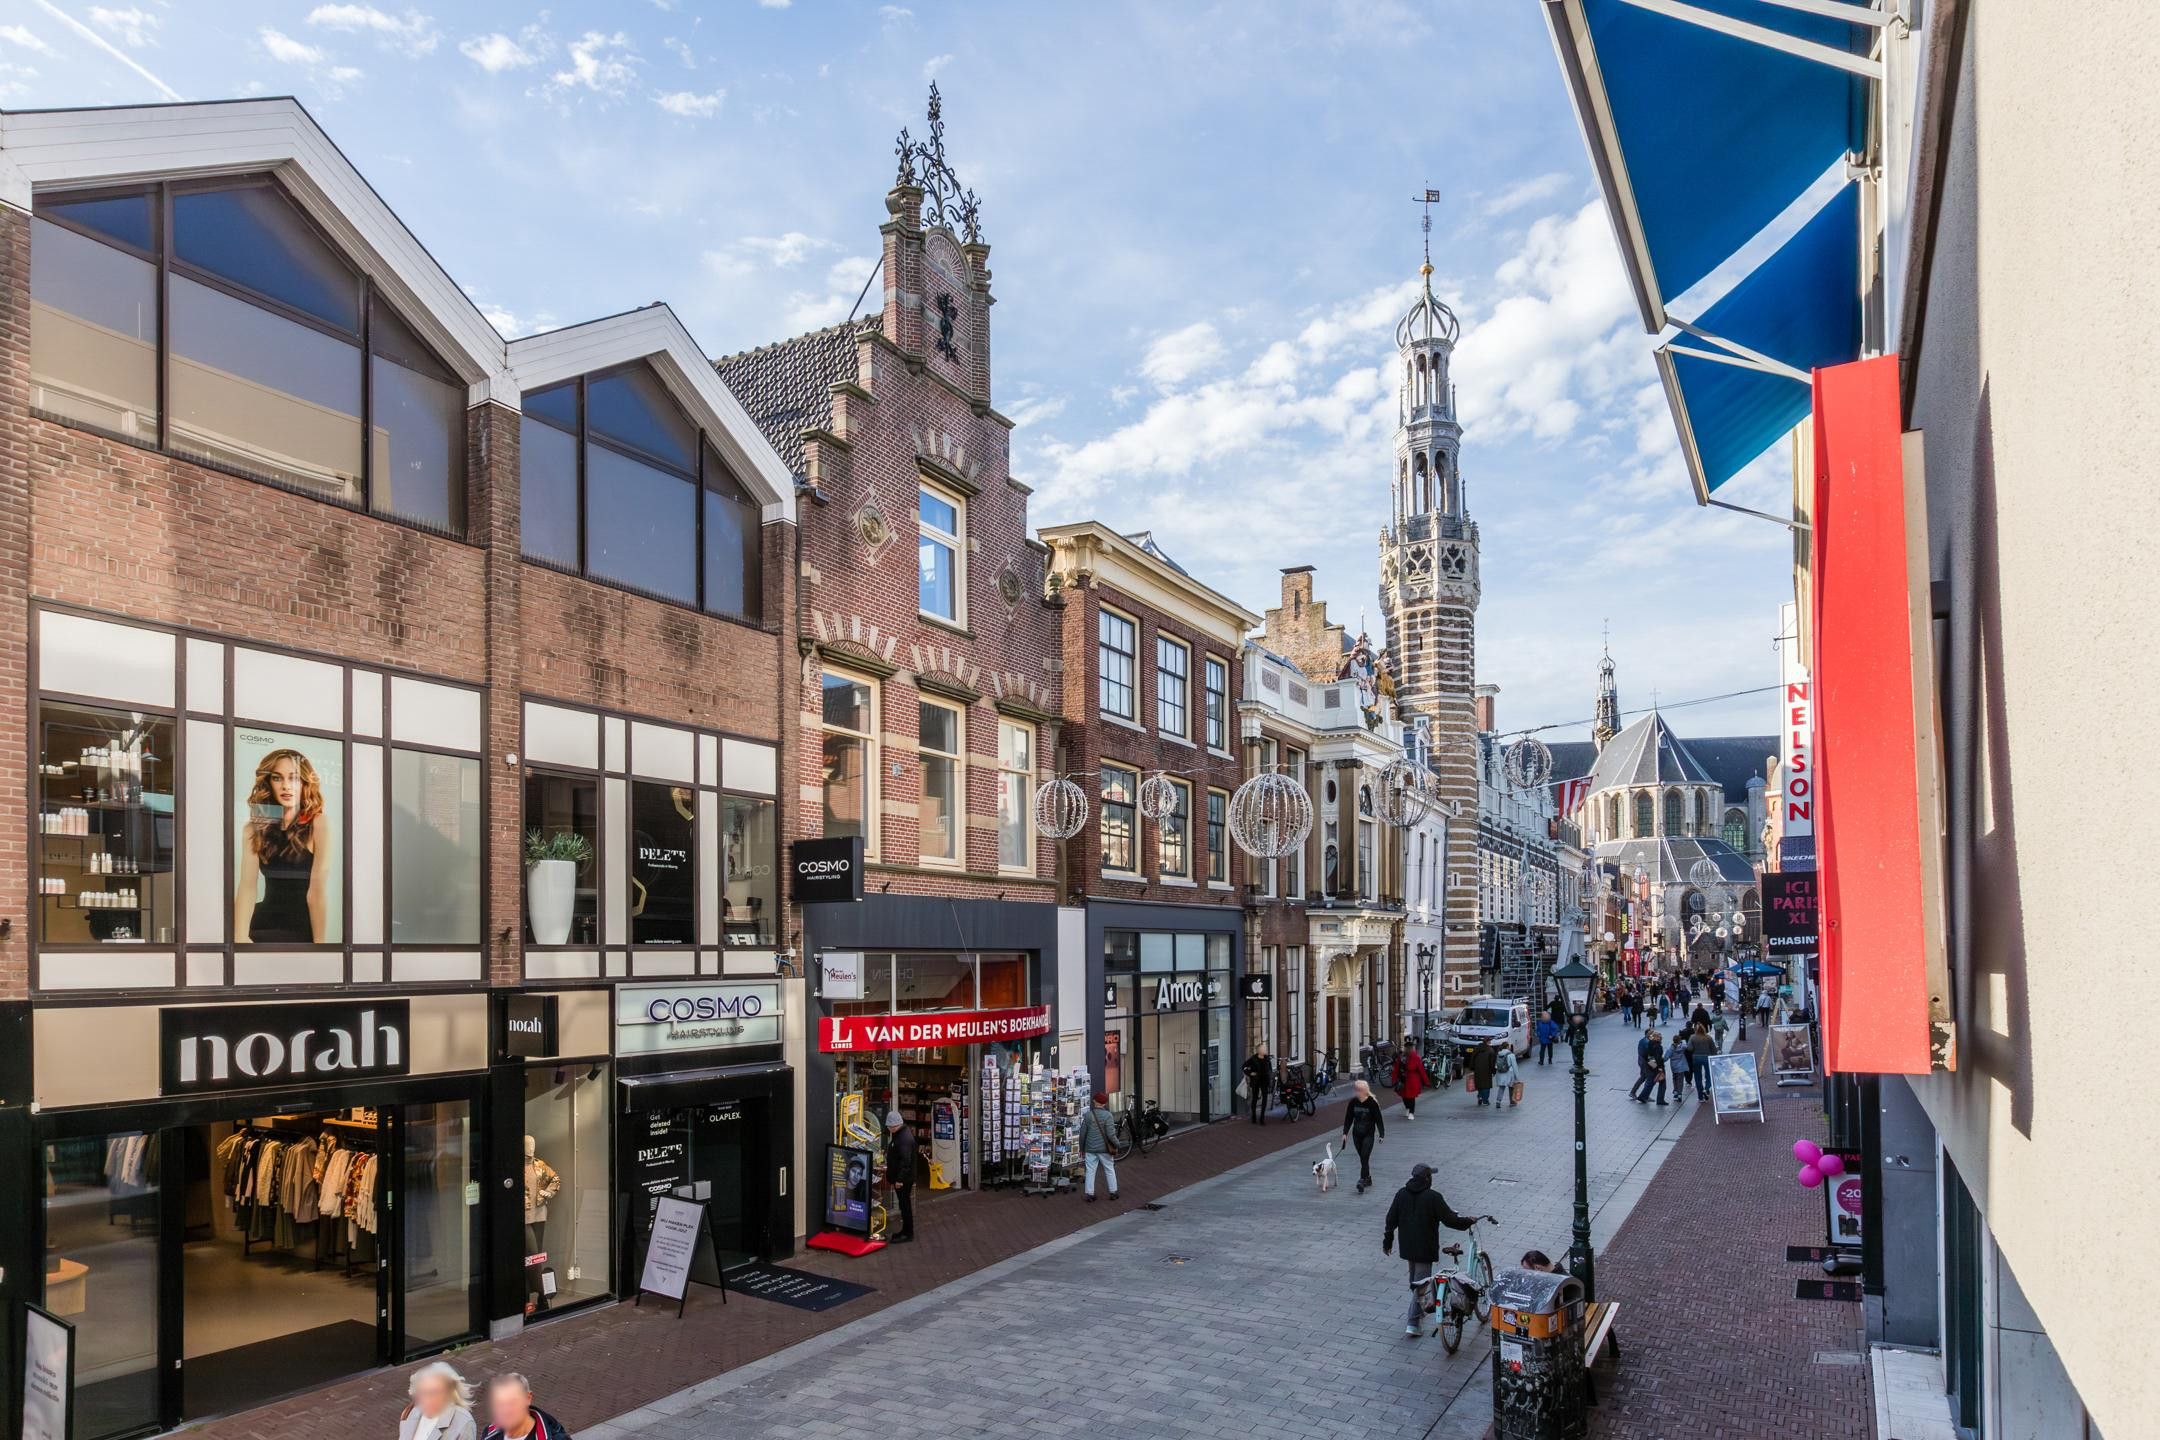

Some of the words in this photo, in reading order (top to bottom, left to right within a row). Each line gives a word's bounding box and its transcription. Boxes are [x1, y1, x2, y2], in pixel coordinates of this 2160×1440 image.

[240, 734, 274, 744] COSMO
[1787, 683, 1810, 821] NELSON
[640, 847, 686, 862] DELETE
[798, 859, 850, 873] COSMO
[1785, 881, 1810, 895] ICI
[1789, 911, 1810, 924] XL
[1769, 935, 1819, 946] CHASIN'
[1156, 977, 1203, 1010] Amac
[649, 995, 762, 1023] COSMO
[509, 1017, 542, 1034] norah
[669, 1025, 745, 1040] HAIRSTYLING
[865, 1025, 904, 1042] VAN
[910, 1023, 943, 1041] DER
[947, 1019, 1008, 1039] MEULEN'S
[180, 1010, 400, 1082] norah
[650, 1120, 671, 1129] deleted
[638, 1144, 683, 1162] DELETE
